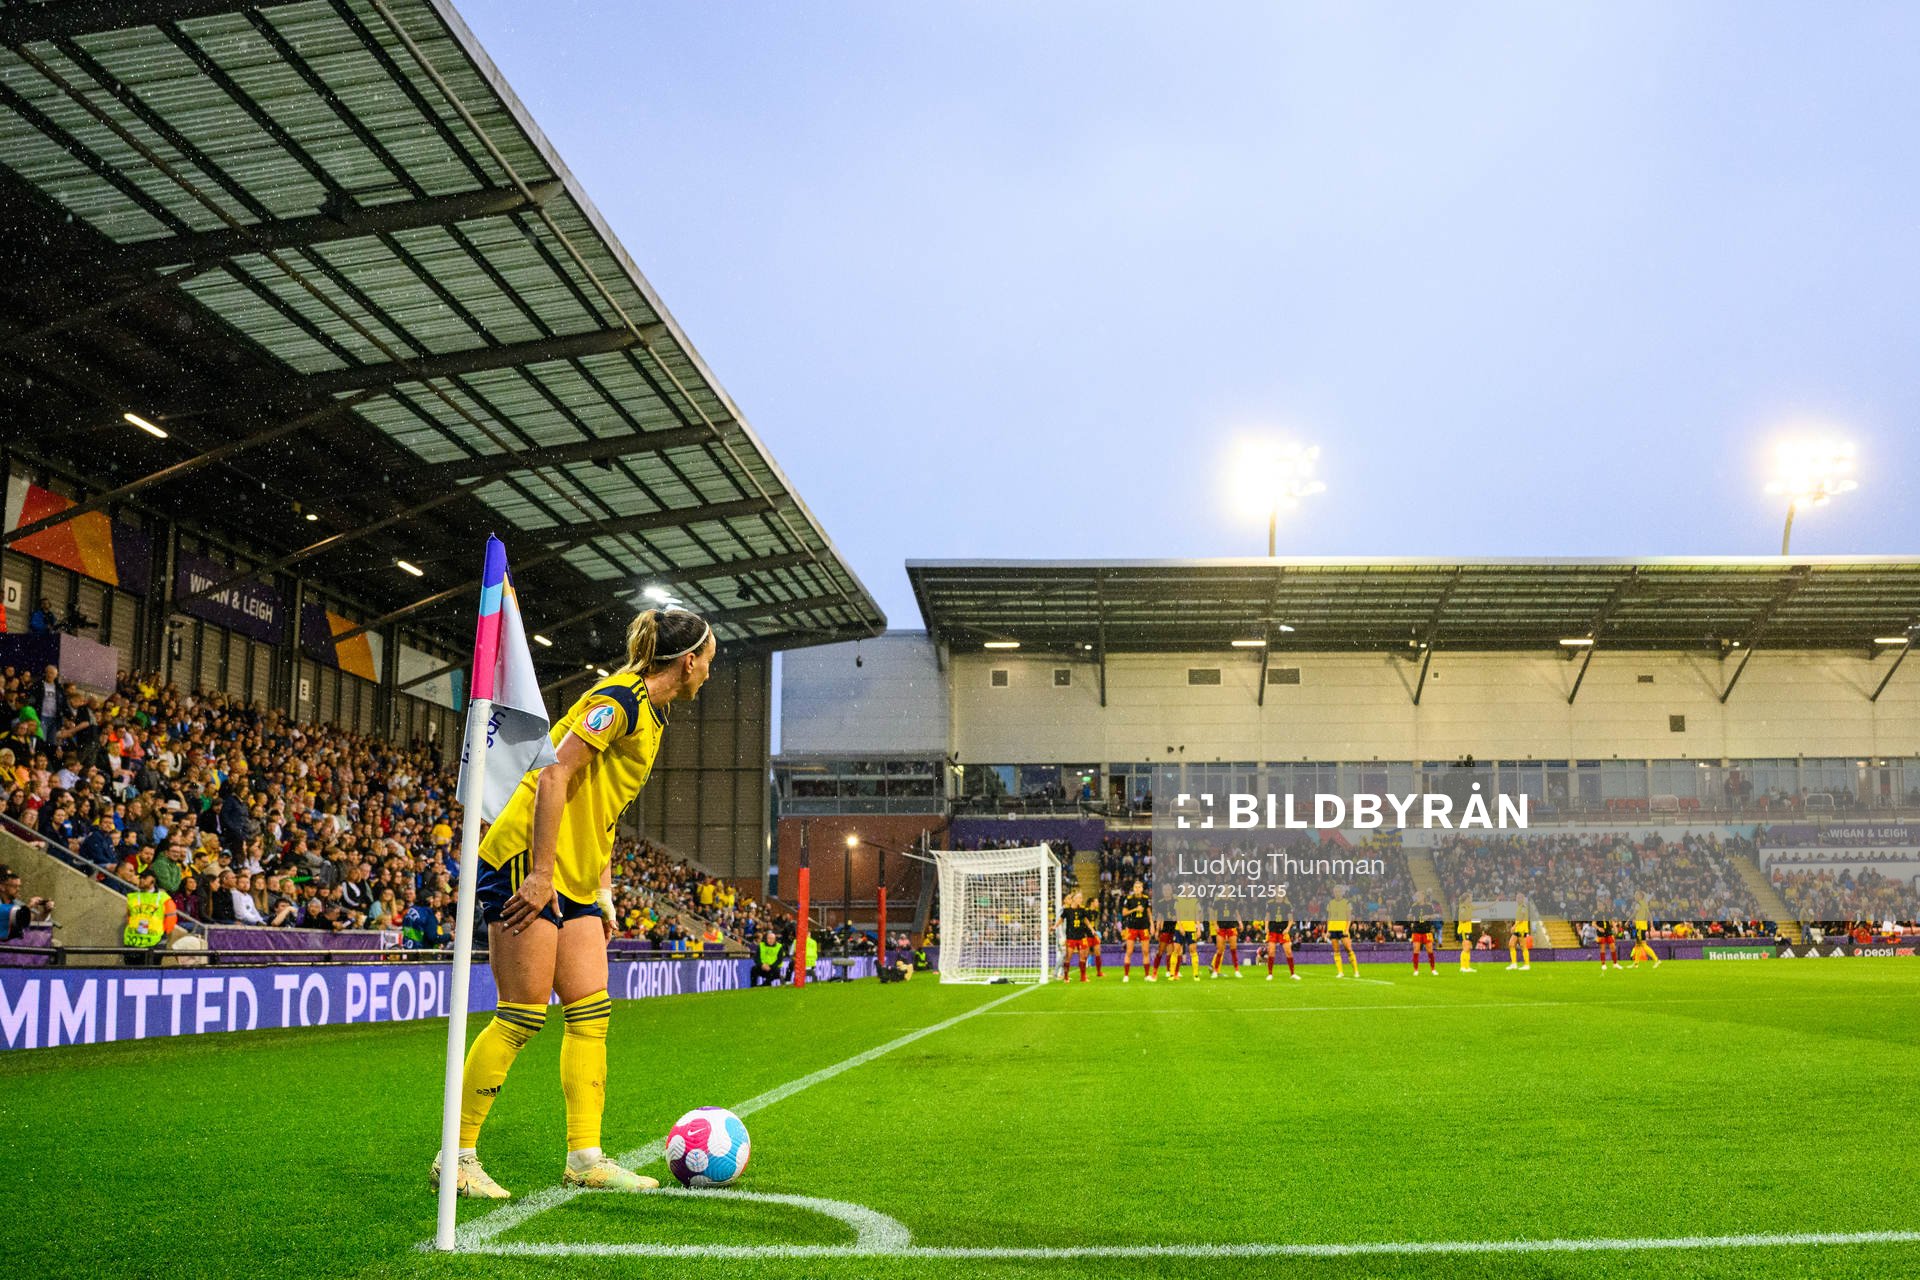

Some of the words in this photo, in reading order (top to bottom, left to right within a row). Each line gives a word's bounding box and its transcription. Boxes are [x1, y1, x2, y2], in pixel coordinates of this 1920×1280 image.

[8, 587, 16, 603] D
[232, 591, 240, 610] &
[243, 595, 273, 624] LEIGH
[1829, 829, 1863, 838] WIGAN
[1867, 829, 1874, 838] &
[1878, 829, 1908, 838] LEIGH
[1709, 951, 1759, 960] Heineken
[1864, 948, 1893, 958] pepsi
[274, 973, 330, 1028] TO
[346, 970, 451, 1024] PEOPL
